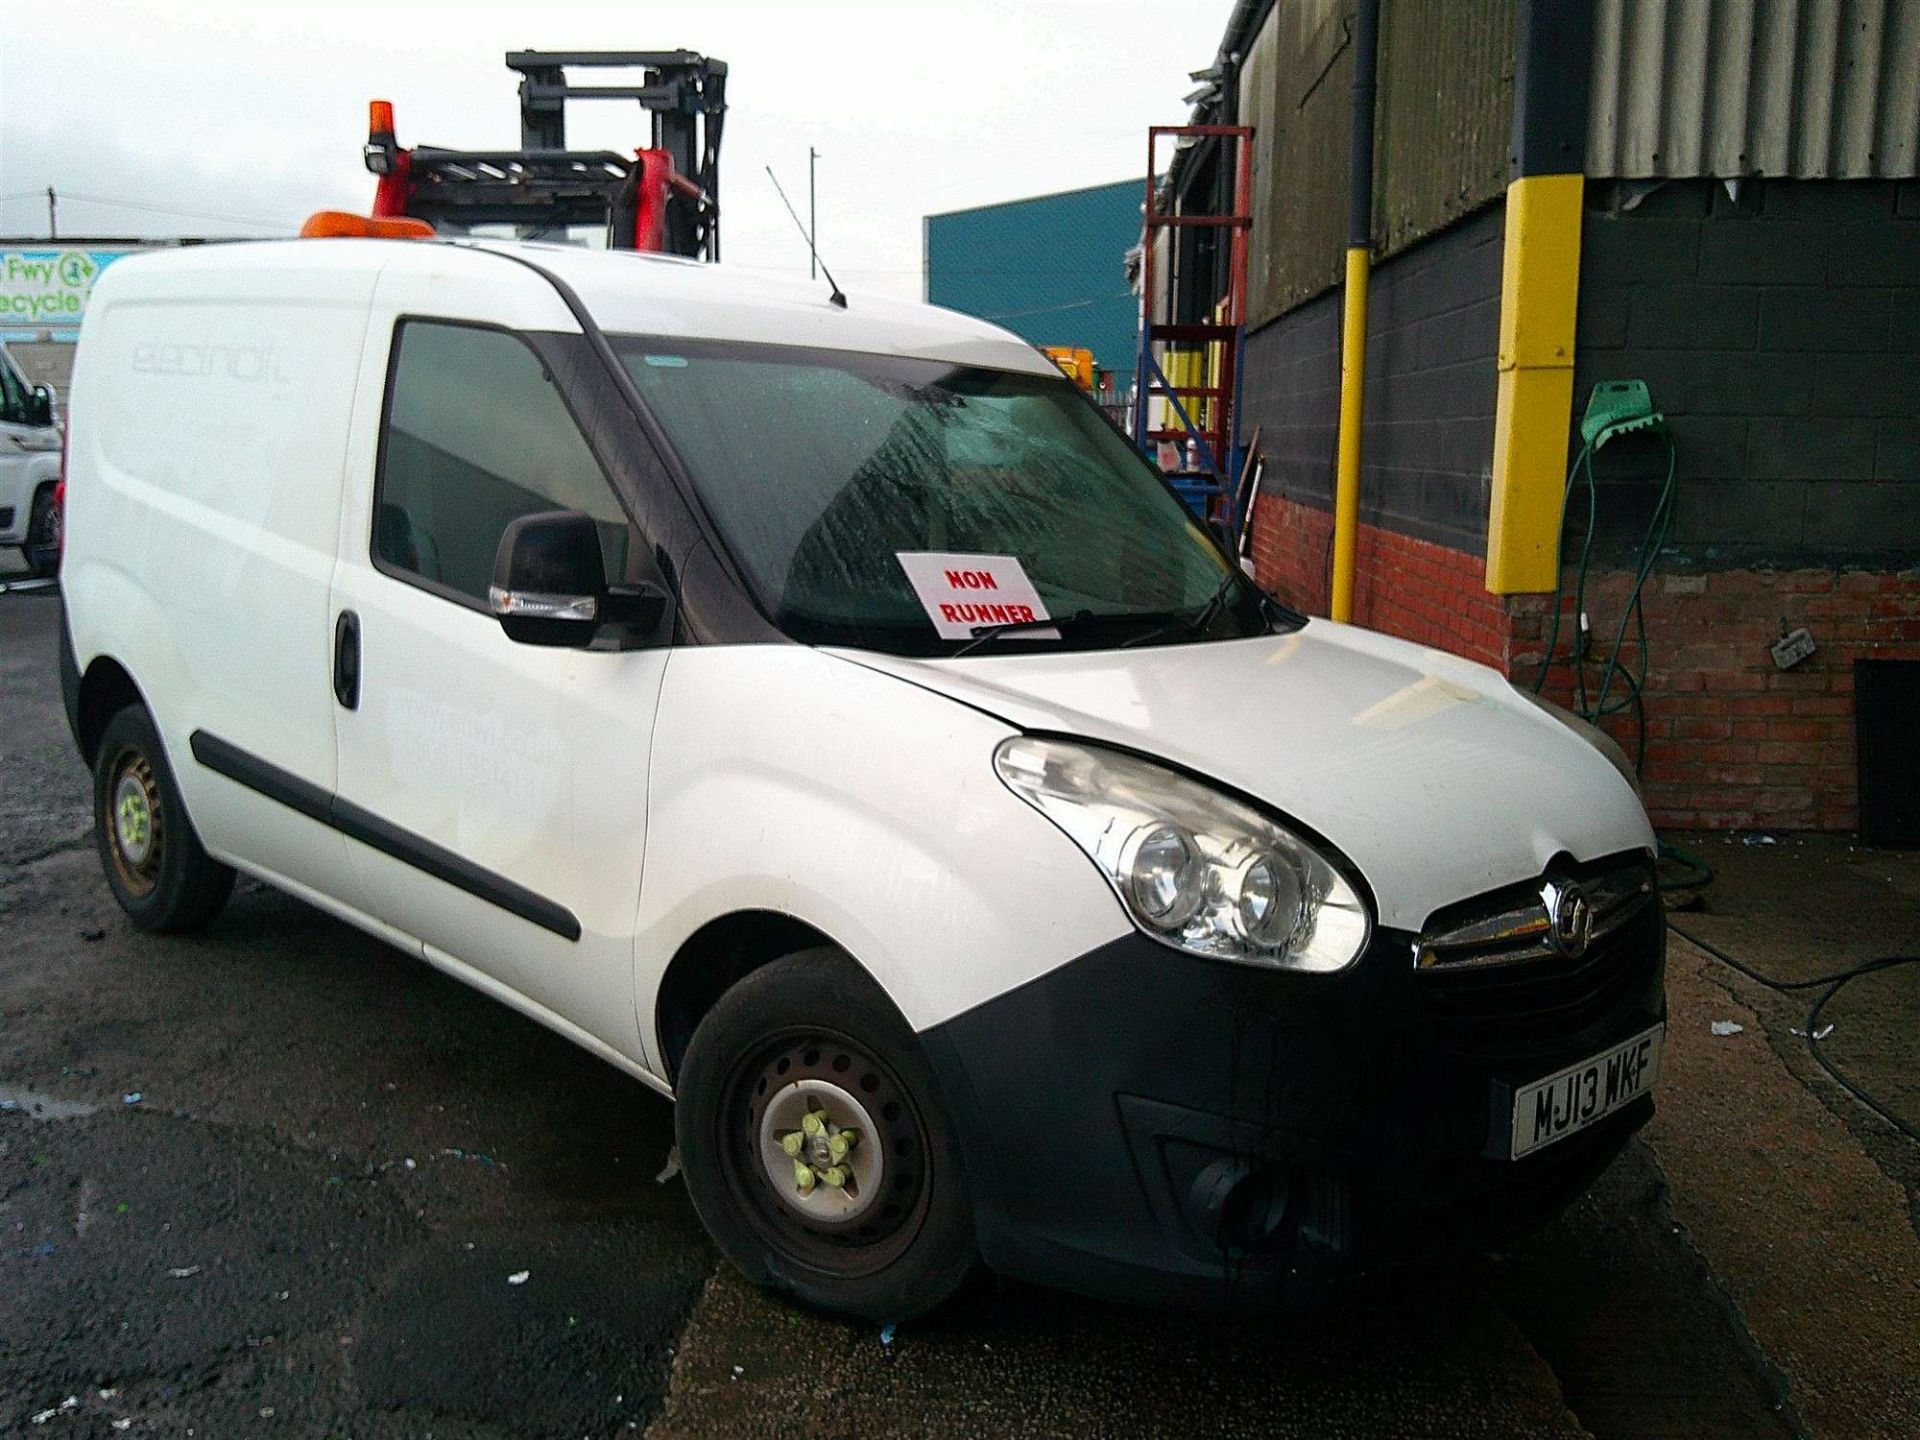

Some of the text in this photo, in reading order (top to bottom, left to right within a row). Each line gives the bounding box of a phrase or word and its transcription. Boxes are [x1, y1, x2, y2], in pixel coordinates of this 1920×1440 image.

[944, 570, 998, 590] NON
[940, 604, 1036, 624] RUNNER
[1533, 1039, 1652, 1142] MJ13 WKF
